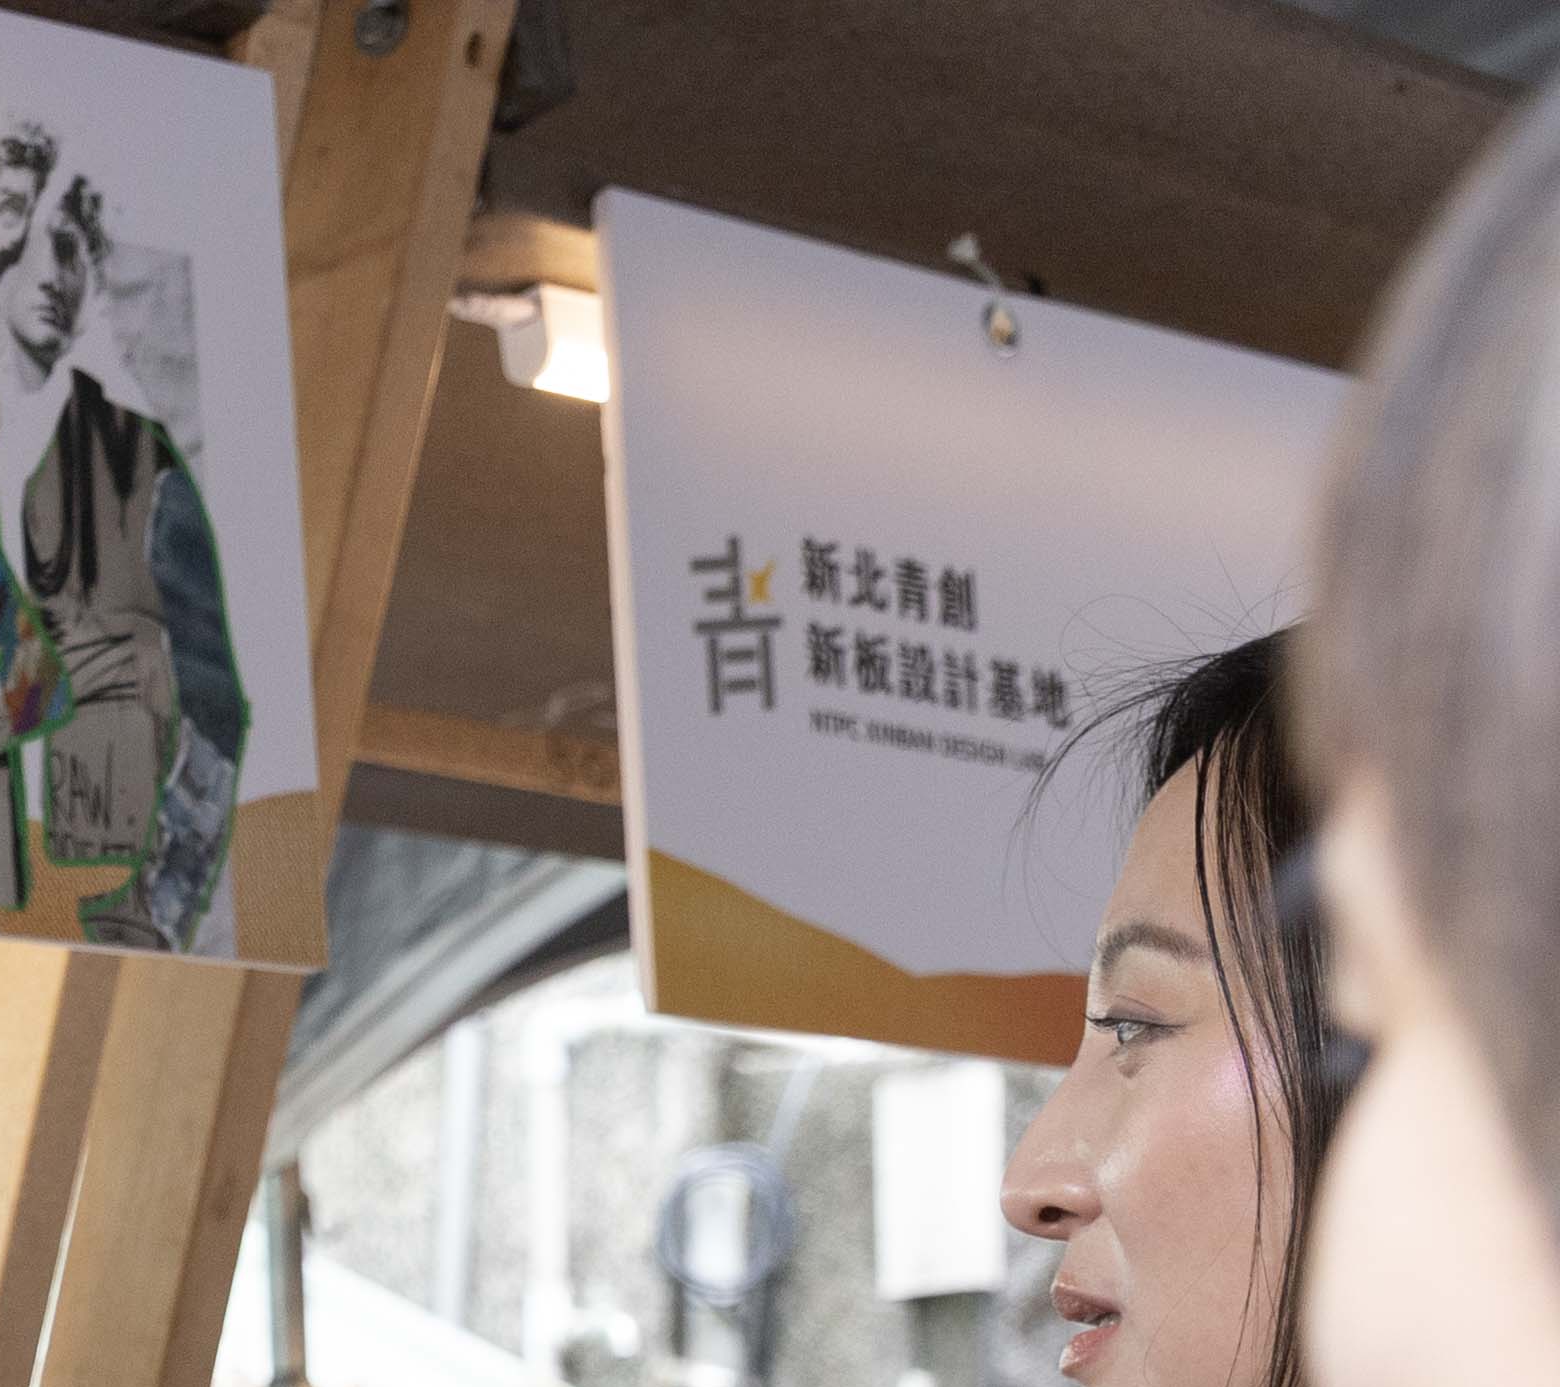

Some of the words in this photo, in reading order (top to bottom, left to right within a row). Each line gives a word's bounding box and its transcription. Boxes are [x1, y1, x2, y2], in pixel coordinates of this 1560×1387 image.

[802, 535, 978, 634] 新北青創
[806, 620, 1071, 730] 新板設計基地
